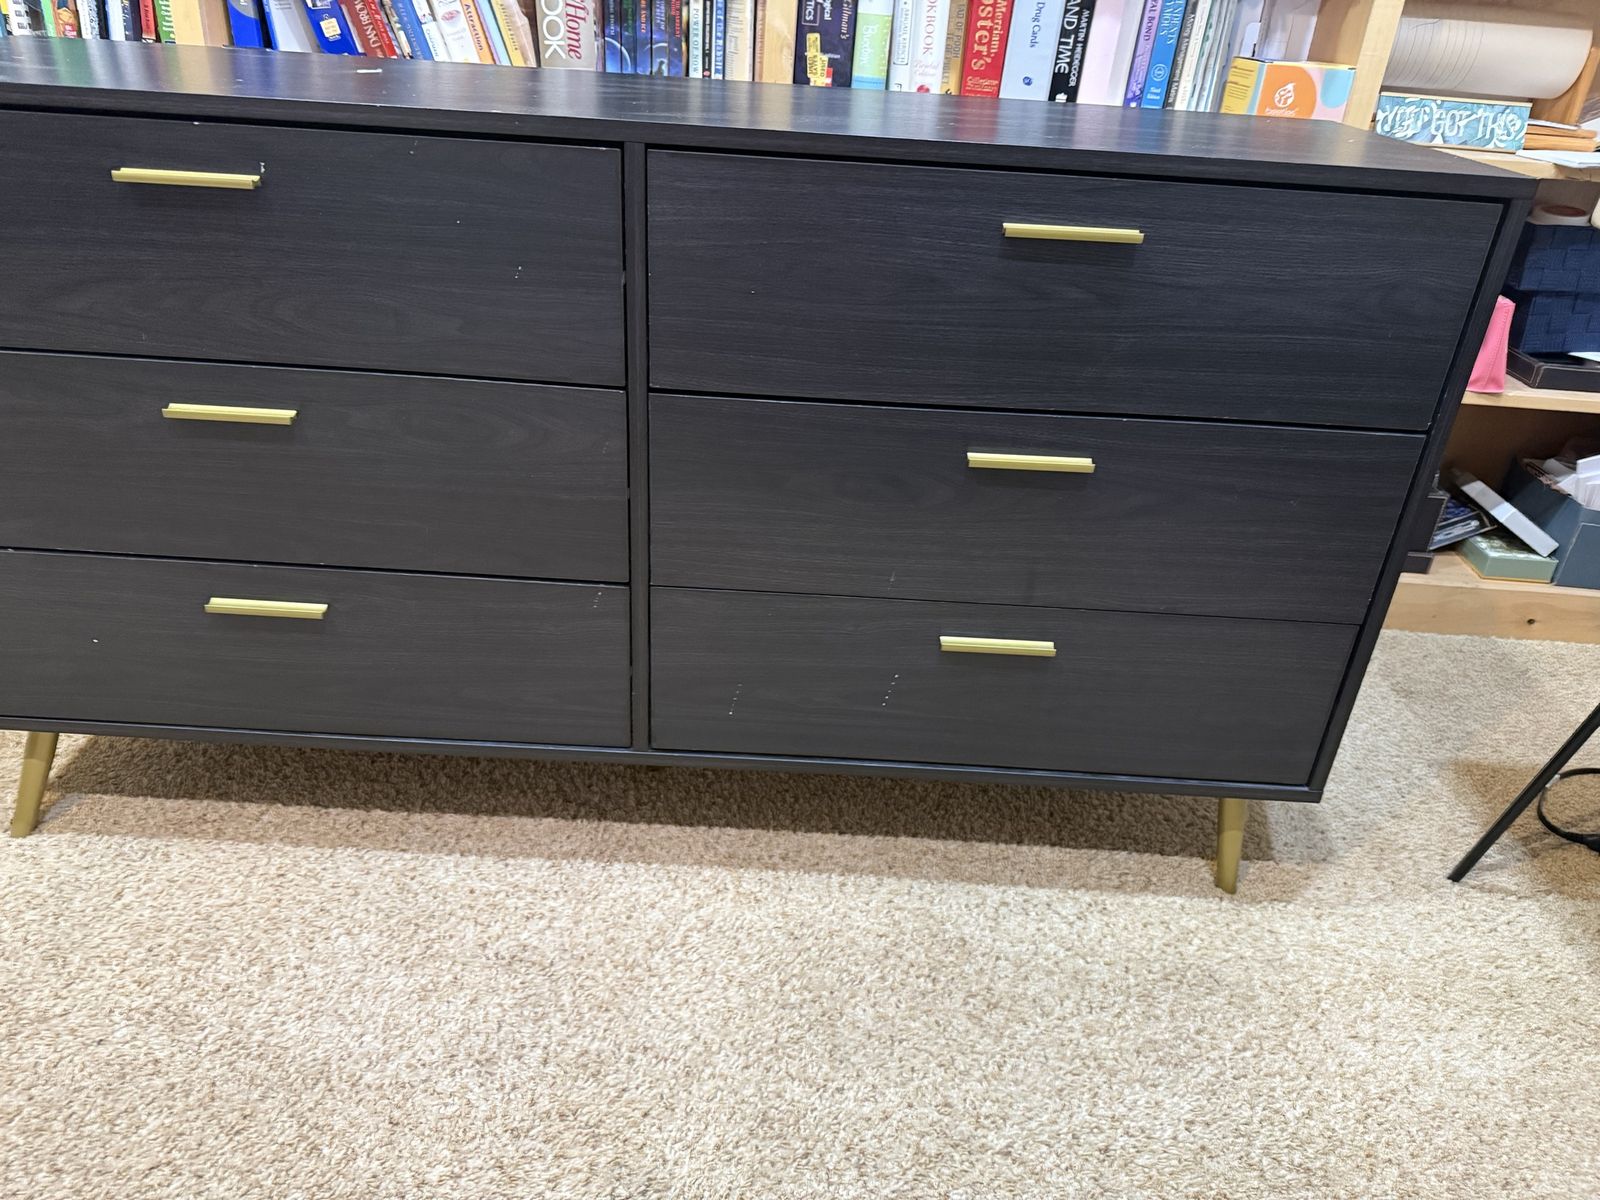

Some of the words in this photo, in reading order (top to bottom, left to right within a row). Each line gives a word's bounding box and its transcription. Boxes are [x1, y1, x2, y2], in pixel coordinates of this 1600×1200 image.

[464, 3, 484, 51] Attraction
[923, 0, 937, 55] KBOOK
[1031, 2, 1045, 23] Drug
[1079, 9, 1090, 42] MARTIN
[1143, 15, 1155, 42] BOND
[364, 24, 381, 48] DAN
[952, 34, 961, 59] POOH
[1029, 24, 1041, 48] Cards
[1055, 34, 1075, 74] TIME
[1068, 43, 1083, 87] HEIDEGGER
[1431, 107, 1471, 137] GOT
[1477, 108, 1522, 141] THIS
